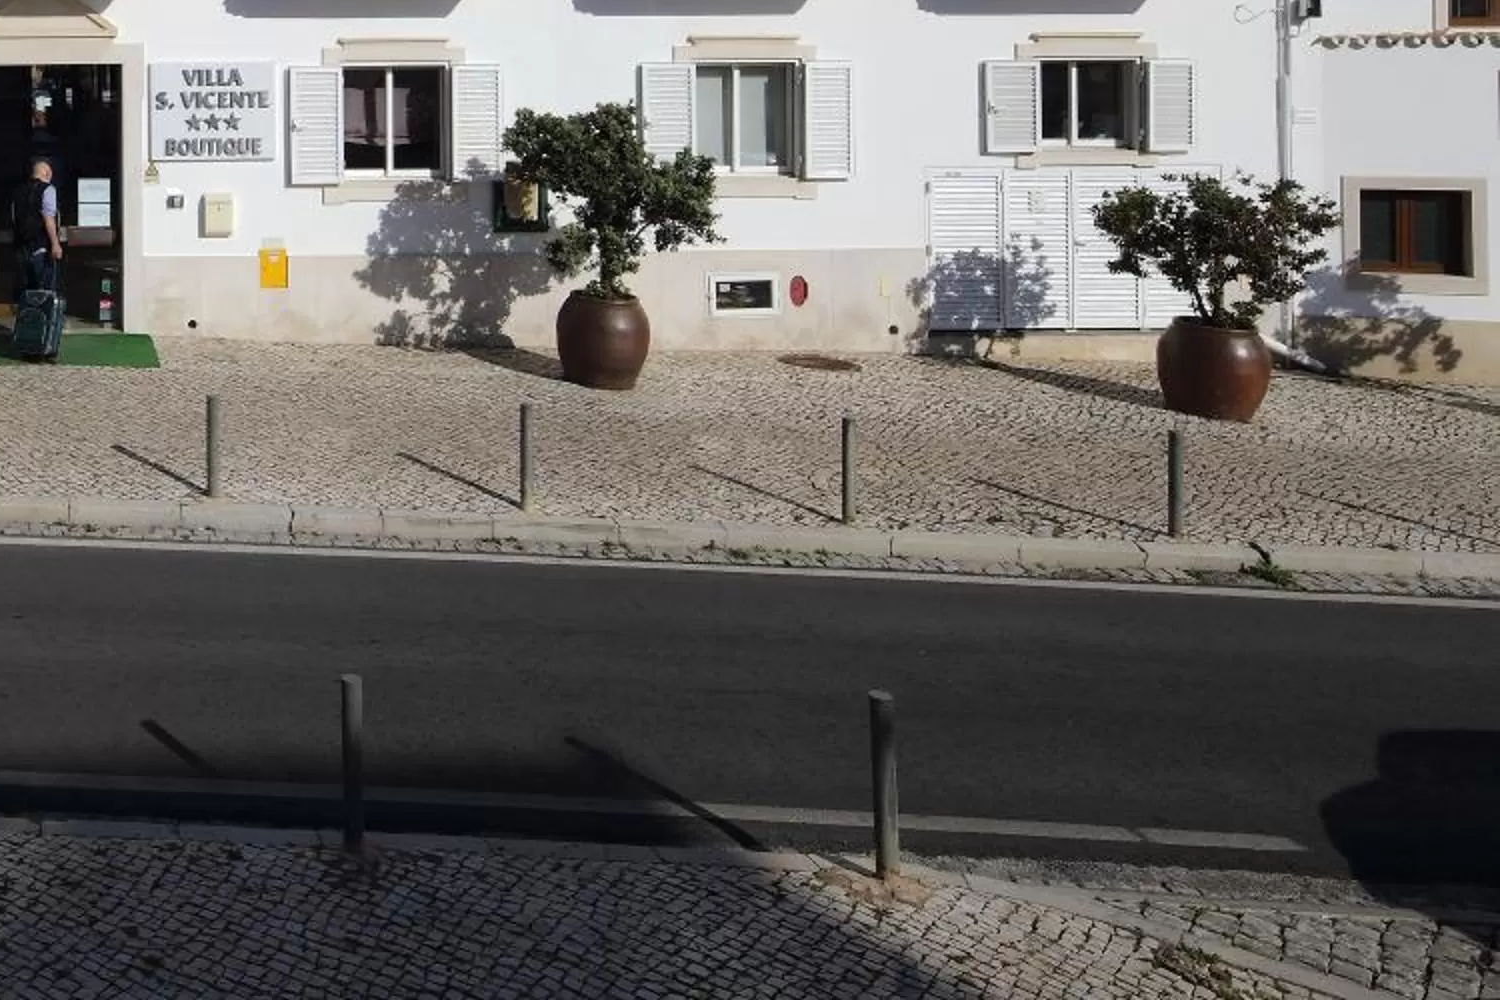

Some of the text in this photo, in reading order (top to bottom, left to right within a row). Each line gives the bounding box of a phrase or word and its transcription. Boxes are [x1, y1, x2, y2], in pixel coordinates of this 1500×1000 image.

[182, 68, 244, 87] VILLA
[179, 91, 271, 109] VICENTE
[165, 138, 263, 157] BOUTIQUE
